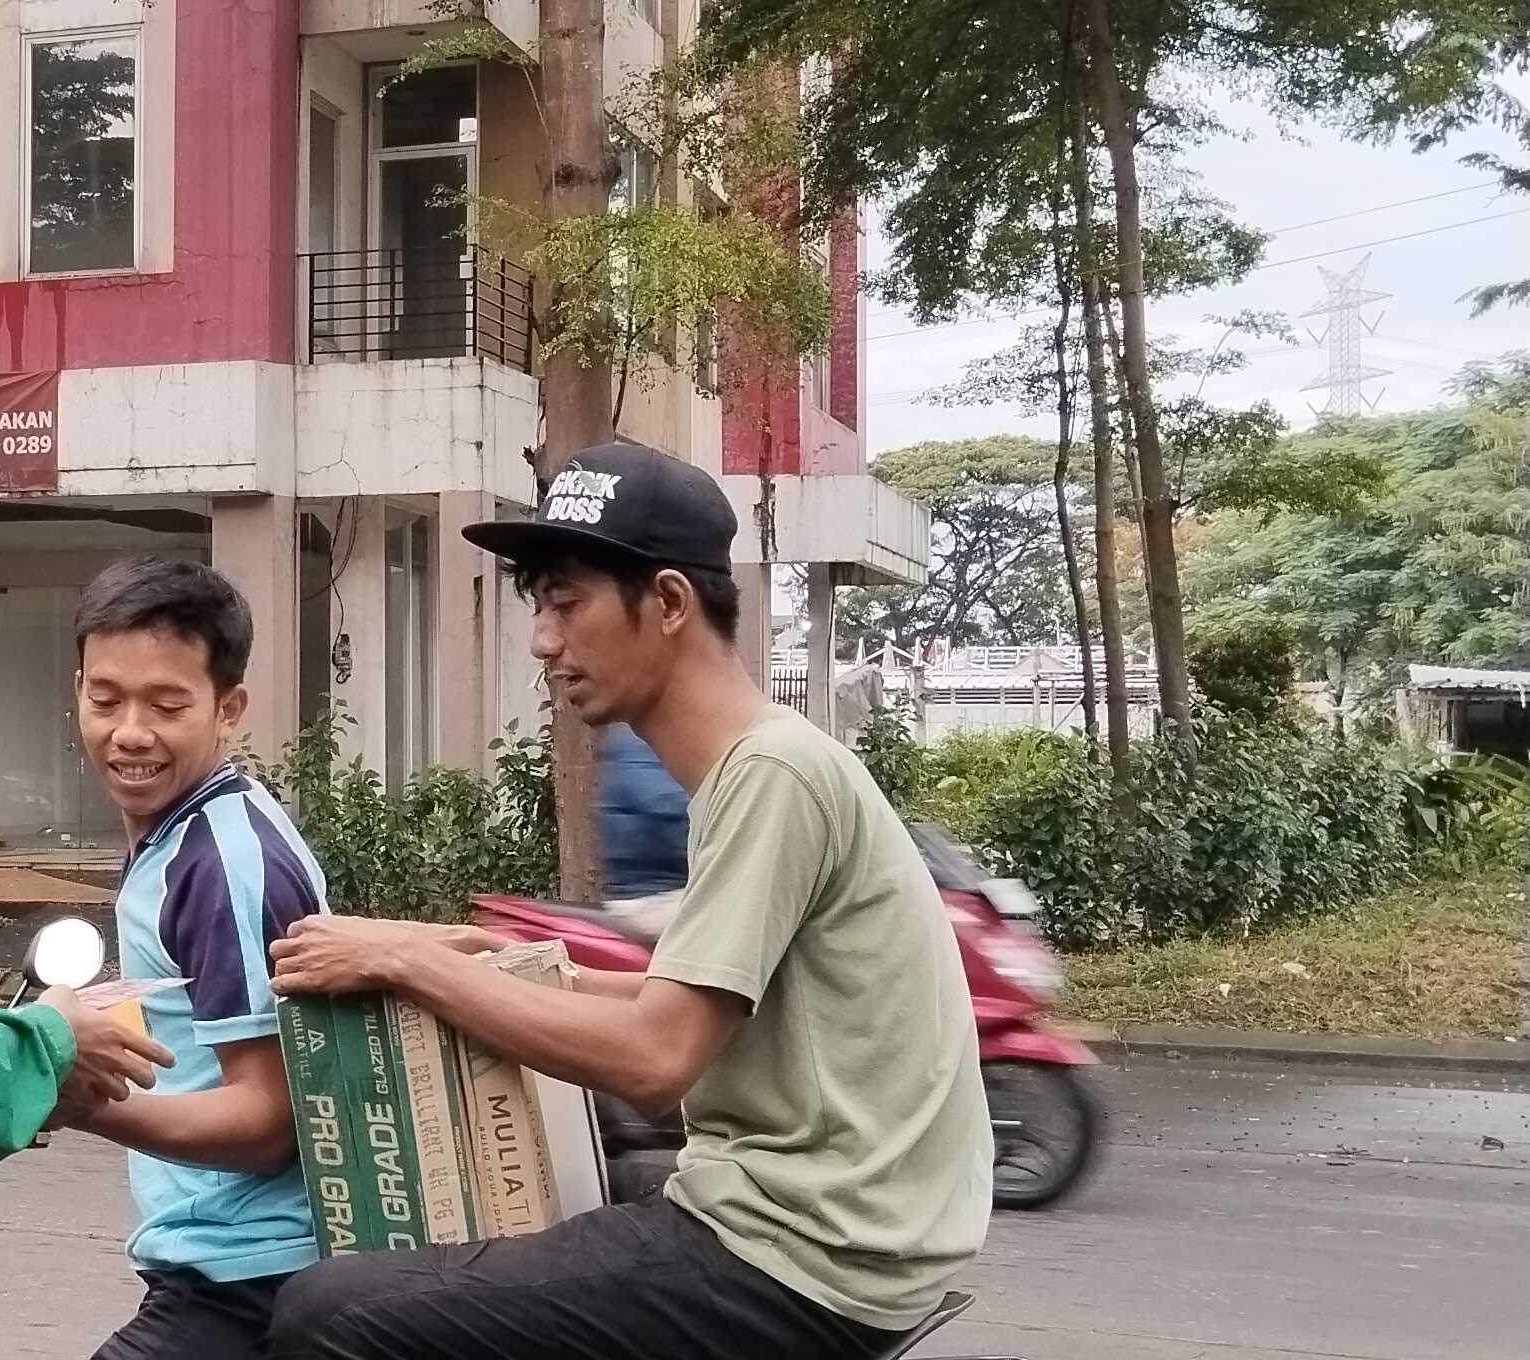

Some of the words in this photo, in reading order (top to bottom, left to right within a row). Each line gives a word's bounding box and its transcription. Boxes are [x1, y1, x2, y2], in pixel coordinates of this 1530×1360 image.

[2, 435, 52, 456] 0289
[546, 496, 605, 524] BOSS
[368, 1036, 389, 1095] GLAZED
[306, 1095, 343, 1166] PRO
[365, 1102, 413, 1222] GRADE
[478, 1126, 491, 1161] BUILD
[486, 1167, 498, 1197] YOUR
[488, 1094, 531, 1227] MULIATI
